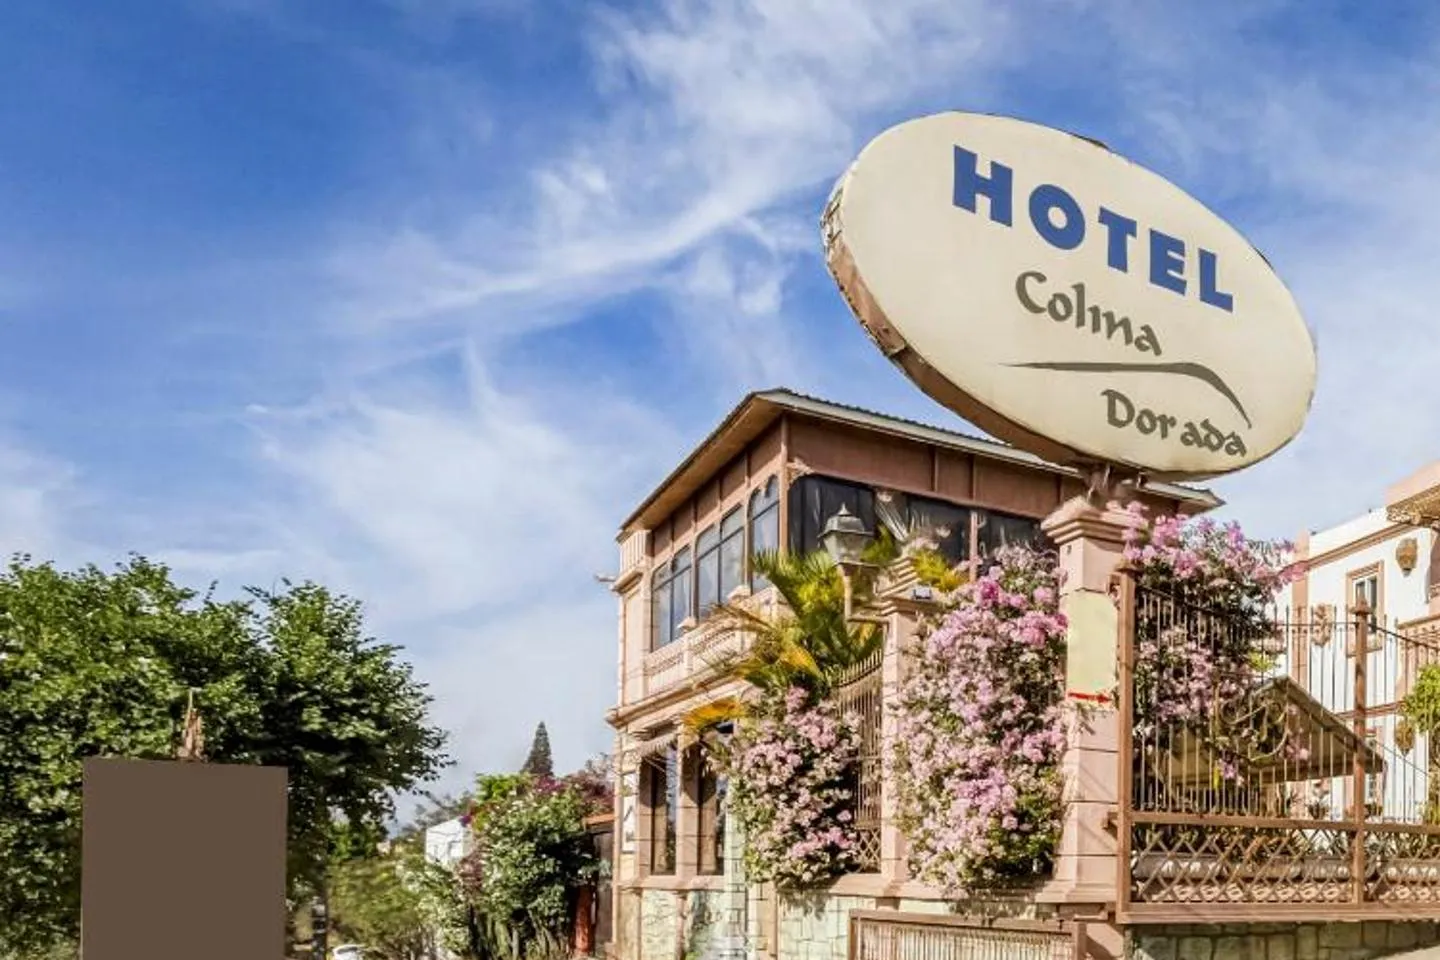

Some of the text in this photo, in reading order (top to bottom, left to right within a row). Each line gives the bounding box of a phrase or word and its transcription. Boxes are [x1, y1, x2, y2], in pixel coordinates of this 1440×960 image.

[952, 145, 1233, 312] HOTEL
[1015, 271, 1162, 356] Colina
[1101, 389, 1247, 457] Dorada
